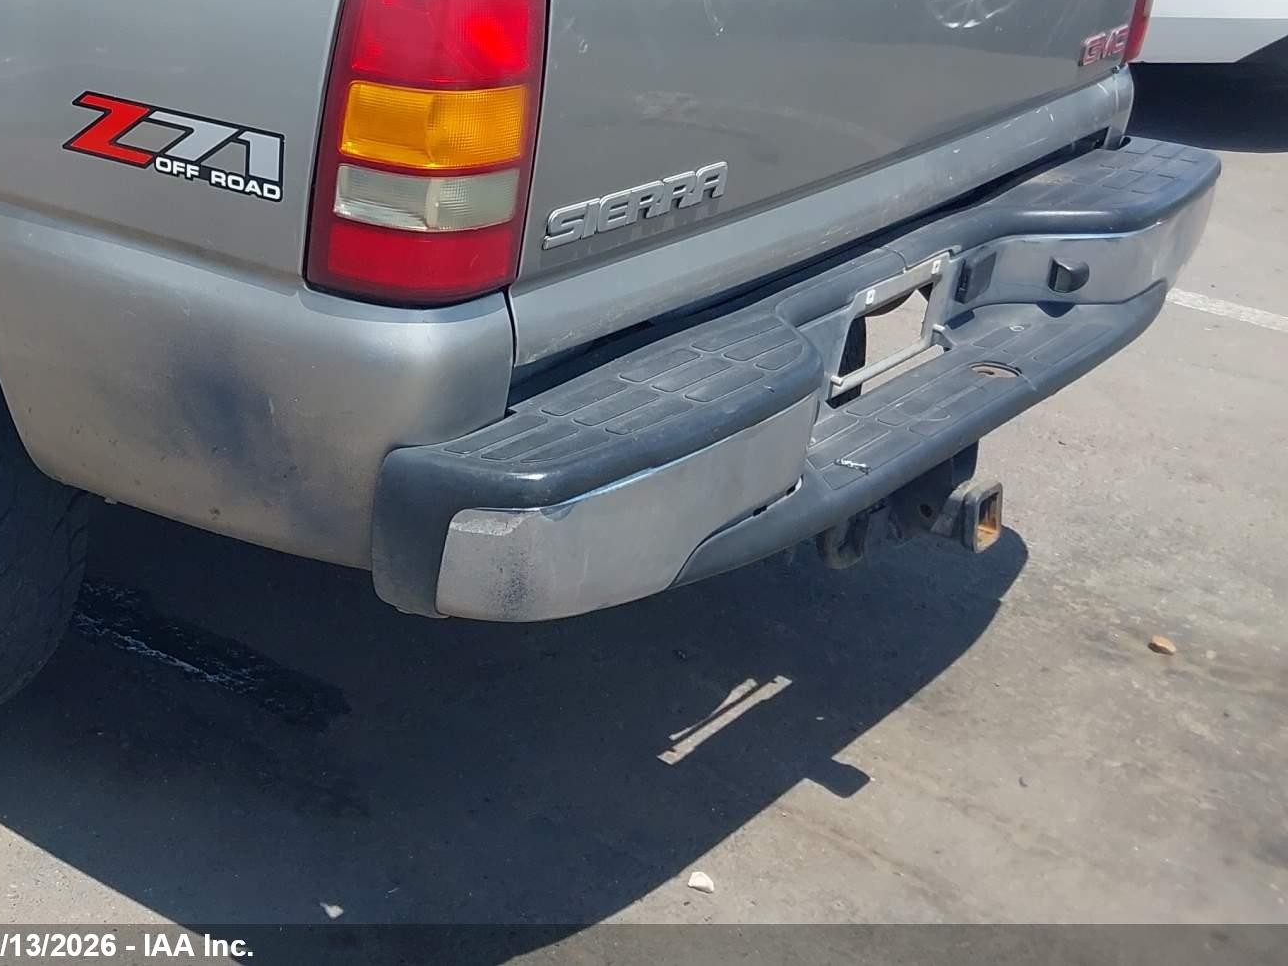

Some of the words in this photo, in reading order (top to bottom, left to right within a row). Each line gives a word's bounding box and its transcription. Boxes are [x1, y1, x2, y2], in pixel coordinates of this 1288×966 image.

[63, 90, 285, 183] Z71
[155, 156, 200, 180] OFF
[210, 170, 281, 201] ROAD
[542, 161, 728, 251] SIERRA
